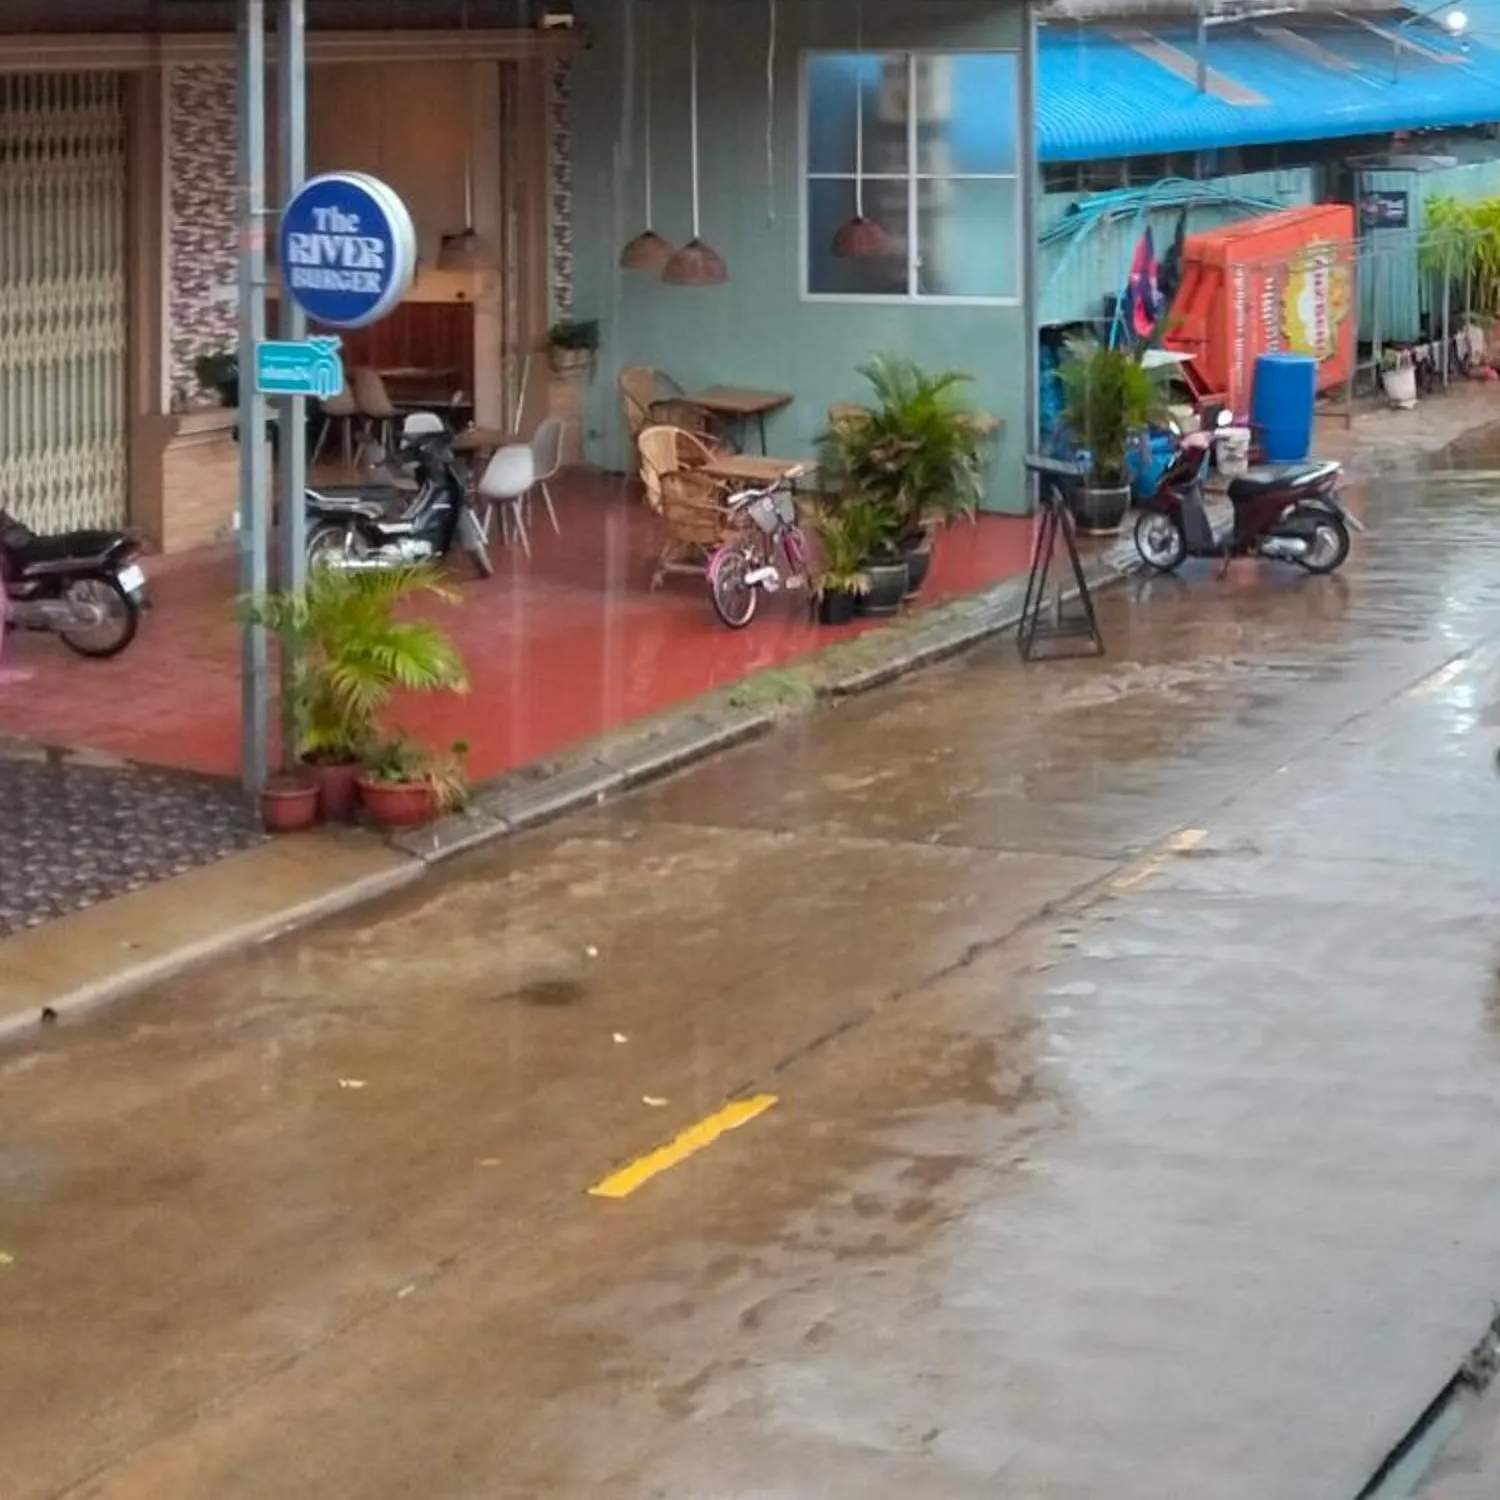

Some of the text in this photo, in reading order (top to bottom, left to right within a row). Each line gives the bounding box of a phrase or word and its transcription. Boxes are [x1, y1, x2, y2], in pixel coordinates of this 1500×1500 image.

[312, 205, 361, 232] The
[288, 232, 385, 269] RIVER
[290, 268, 382, 293] BURGER
